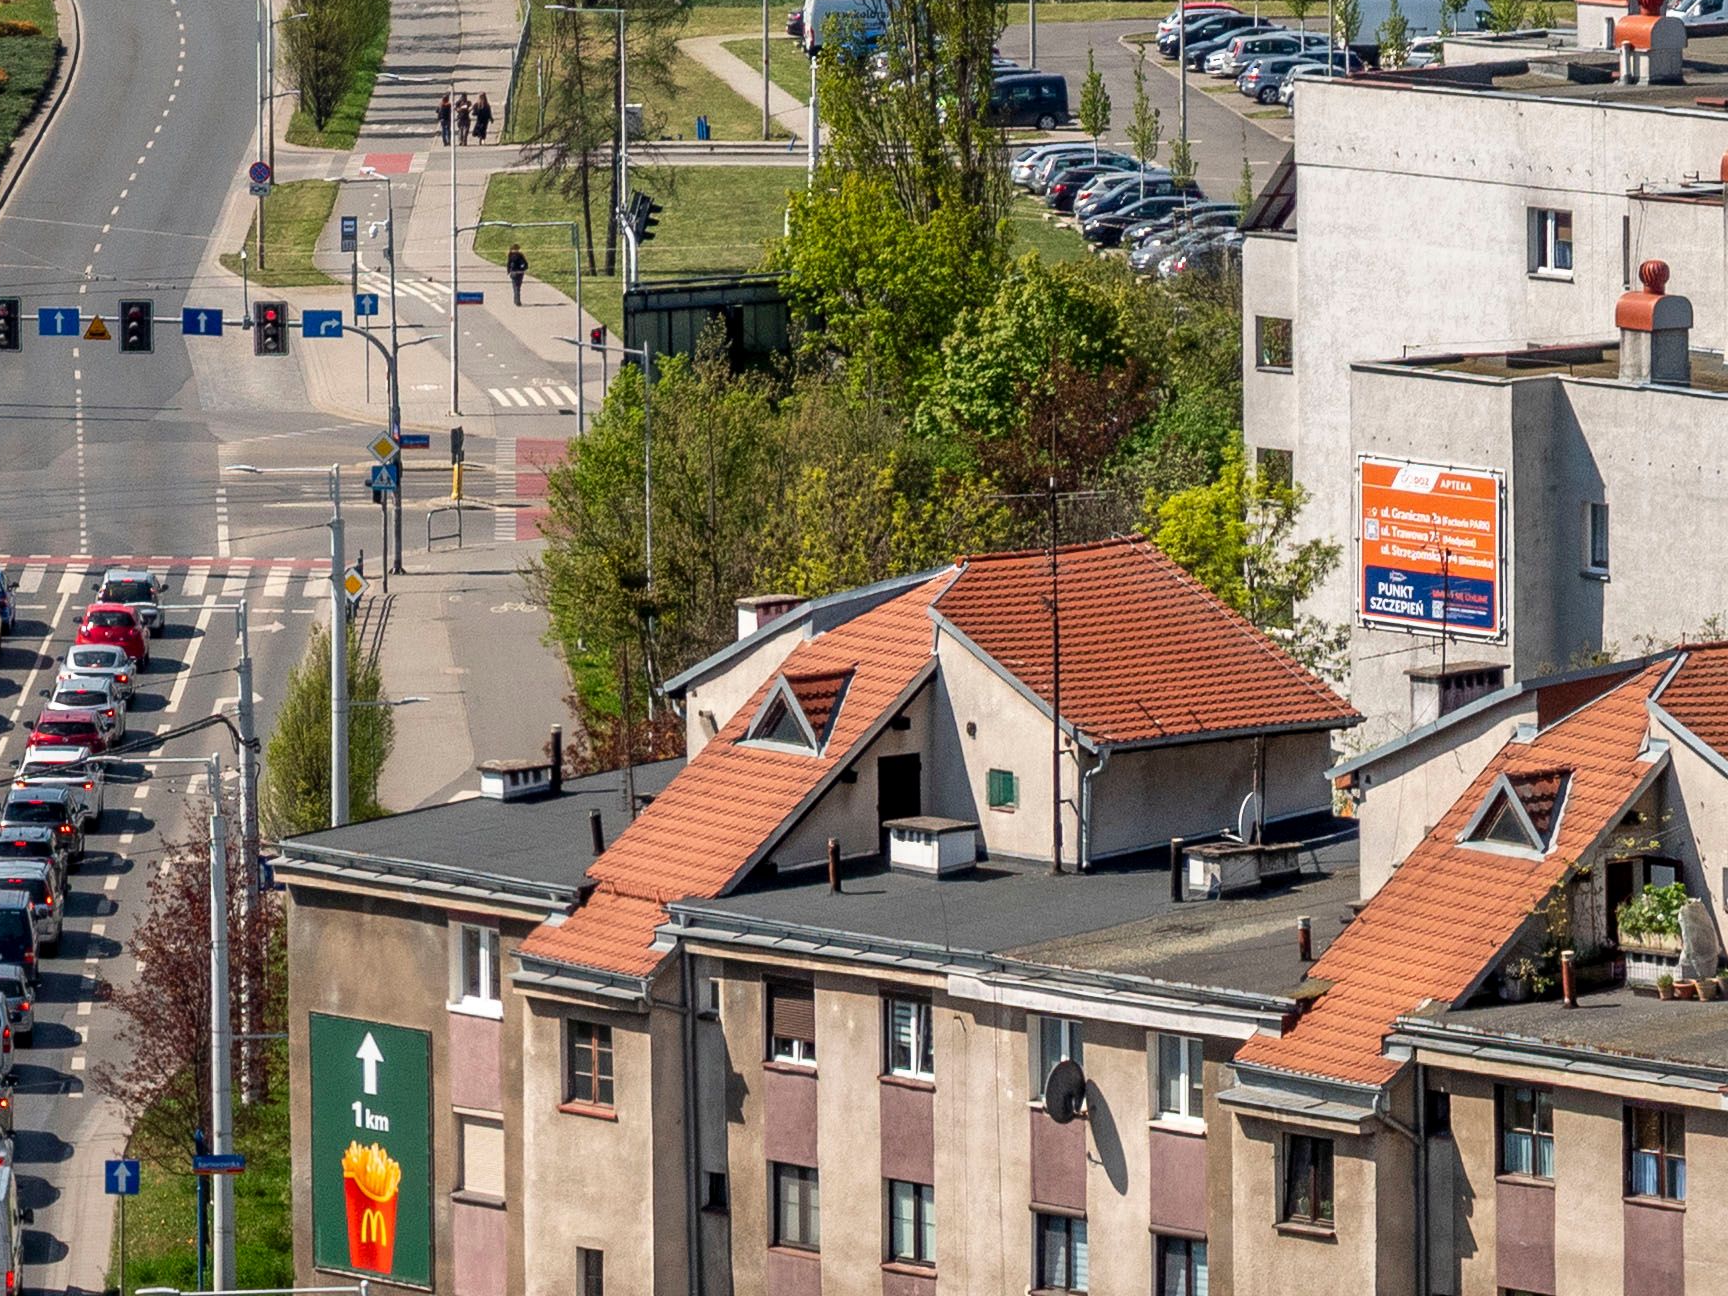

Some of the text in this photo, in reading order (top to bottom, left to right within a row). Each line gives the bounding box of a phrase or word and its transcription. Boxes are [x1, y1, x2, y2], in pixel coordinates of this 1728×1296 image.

[1440, 477, 1472, 493] APTEKA
[1380, 506, 1391, 519] ul.
[1391, 507, 1431, 524] Graniczna
[1380, 524, 1391, 537] ul.
[1391, 525, 1429, 542] Trawowa
[1380, 543, 1391, 556] ul.
[1378, 582, 1414, 598] PUNKT
[1369, 595, 1424, 616] SZCZEPIEŃ
[351, 1100, 390, 1133] 1 km
